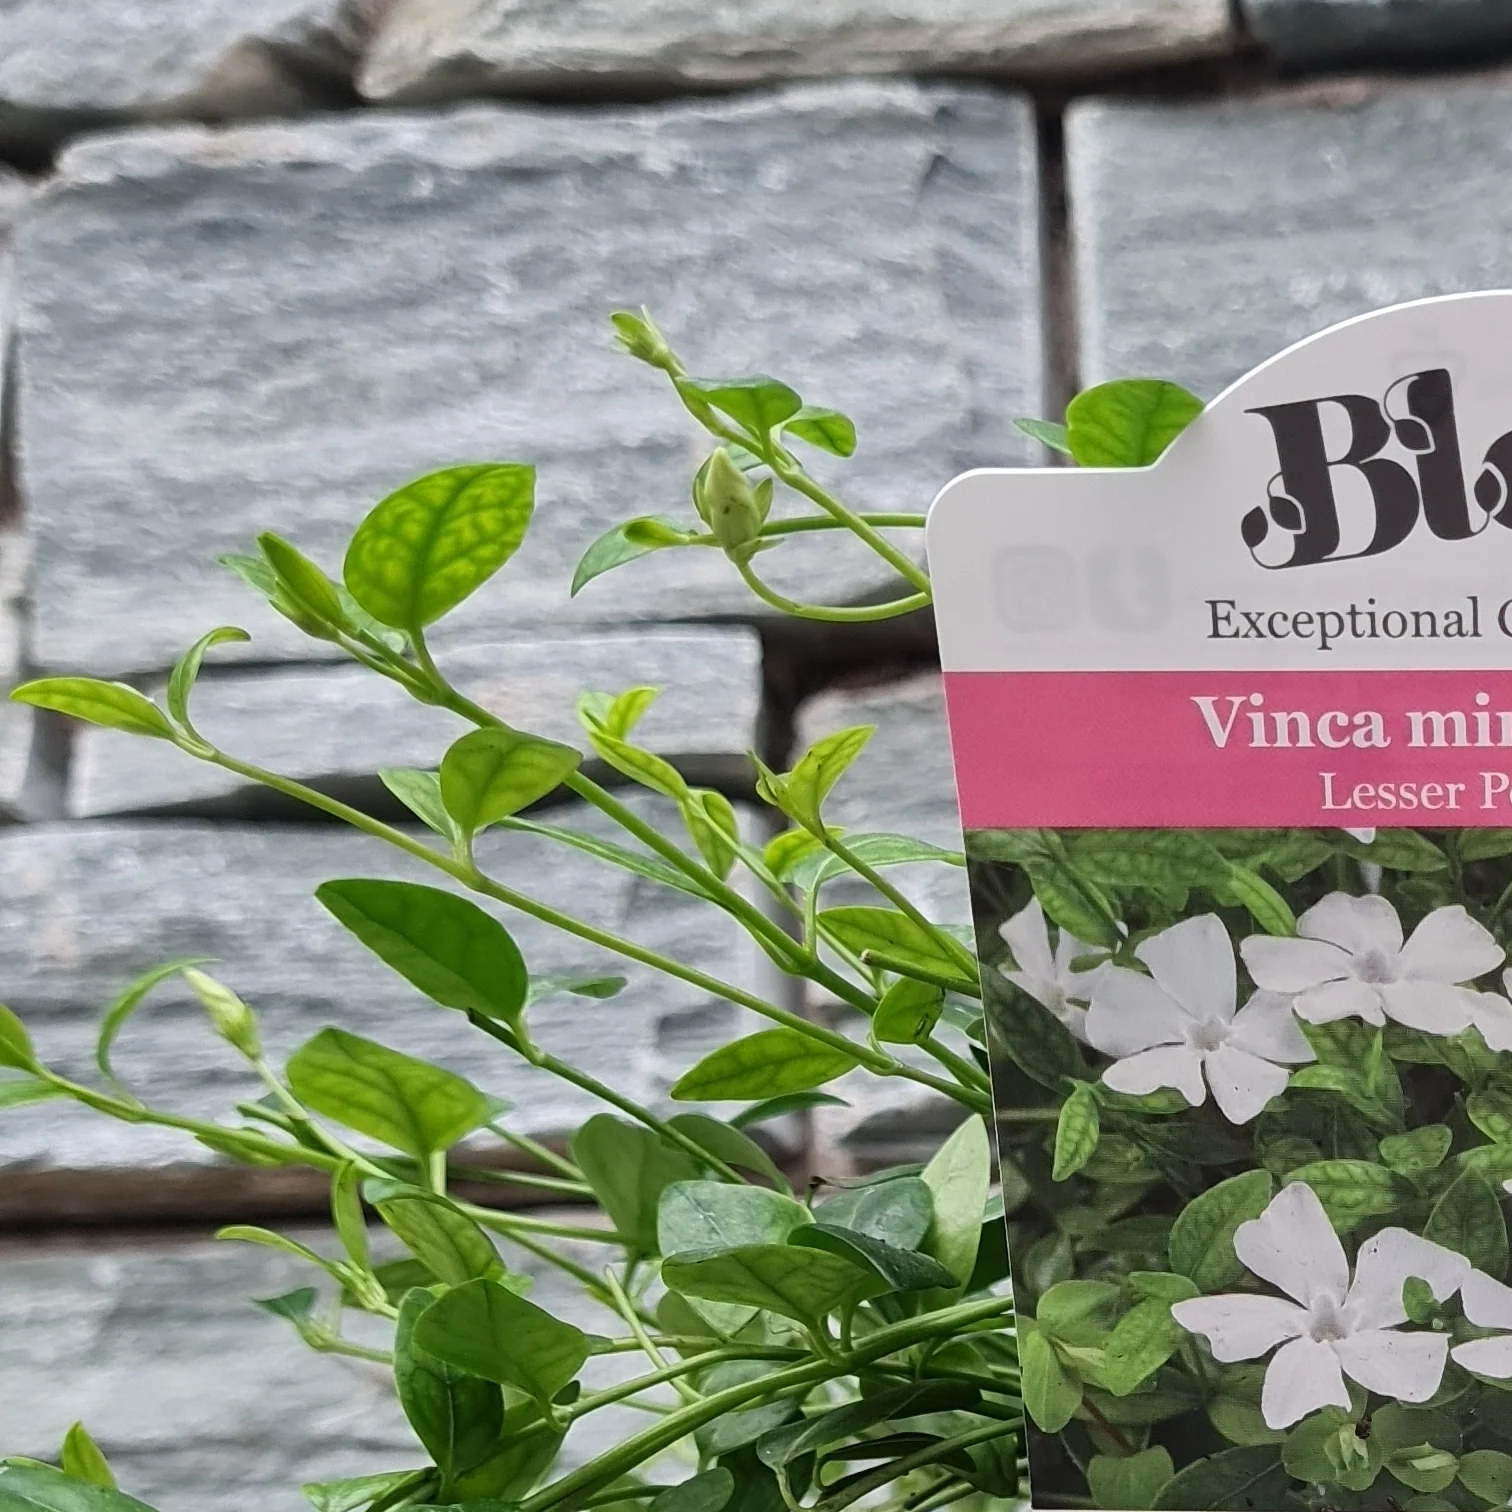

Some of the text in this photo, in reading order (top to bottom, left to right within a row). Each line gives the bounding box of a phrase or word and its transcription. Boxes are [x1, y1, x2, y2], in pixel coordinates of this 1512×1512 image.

[1205, 596, 1484, 652] Exceptional
[1192, 695, 1392, 750] Vinca
[1318, 772, 1468, 812] Lesser
